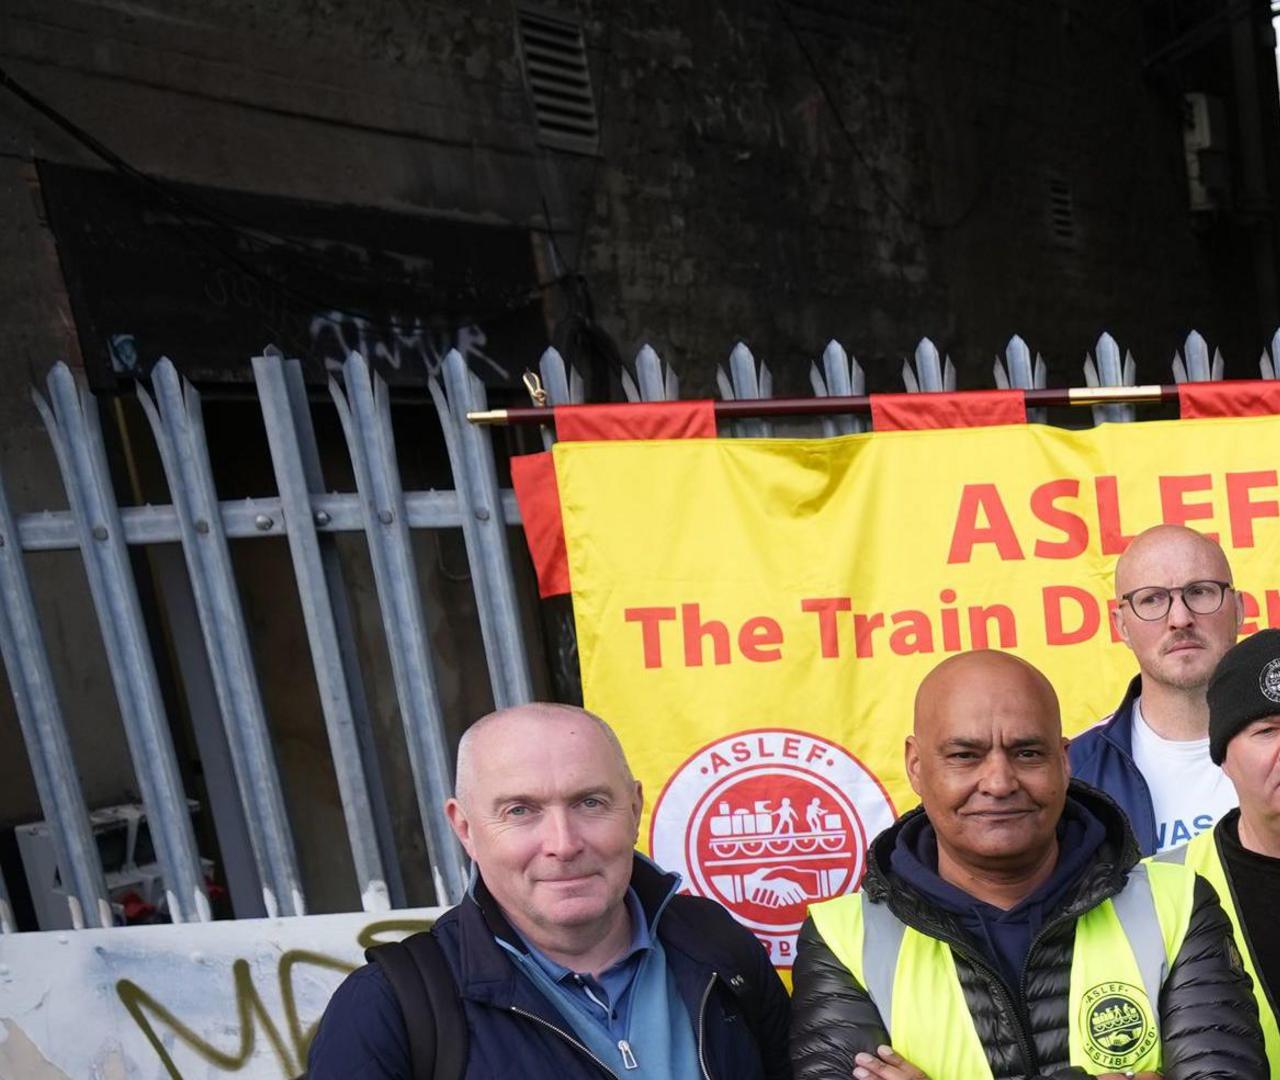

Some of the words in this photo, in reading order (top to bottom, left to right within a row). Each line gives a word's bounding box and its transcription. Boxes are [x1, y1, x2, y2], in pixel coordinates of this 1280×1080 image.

[947, 470, 1280, 564] ASLEF
[624, 602, 785, 669] The
[801, 588, 1019, 660] Train
[709, 736, 829, 775] ASLEF
[1086, 984, 1124, 1004] ASLEF
